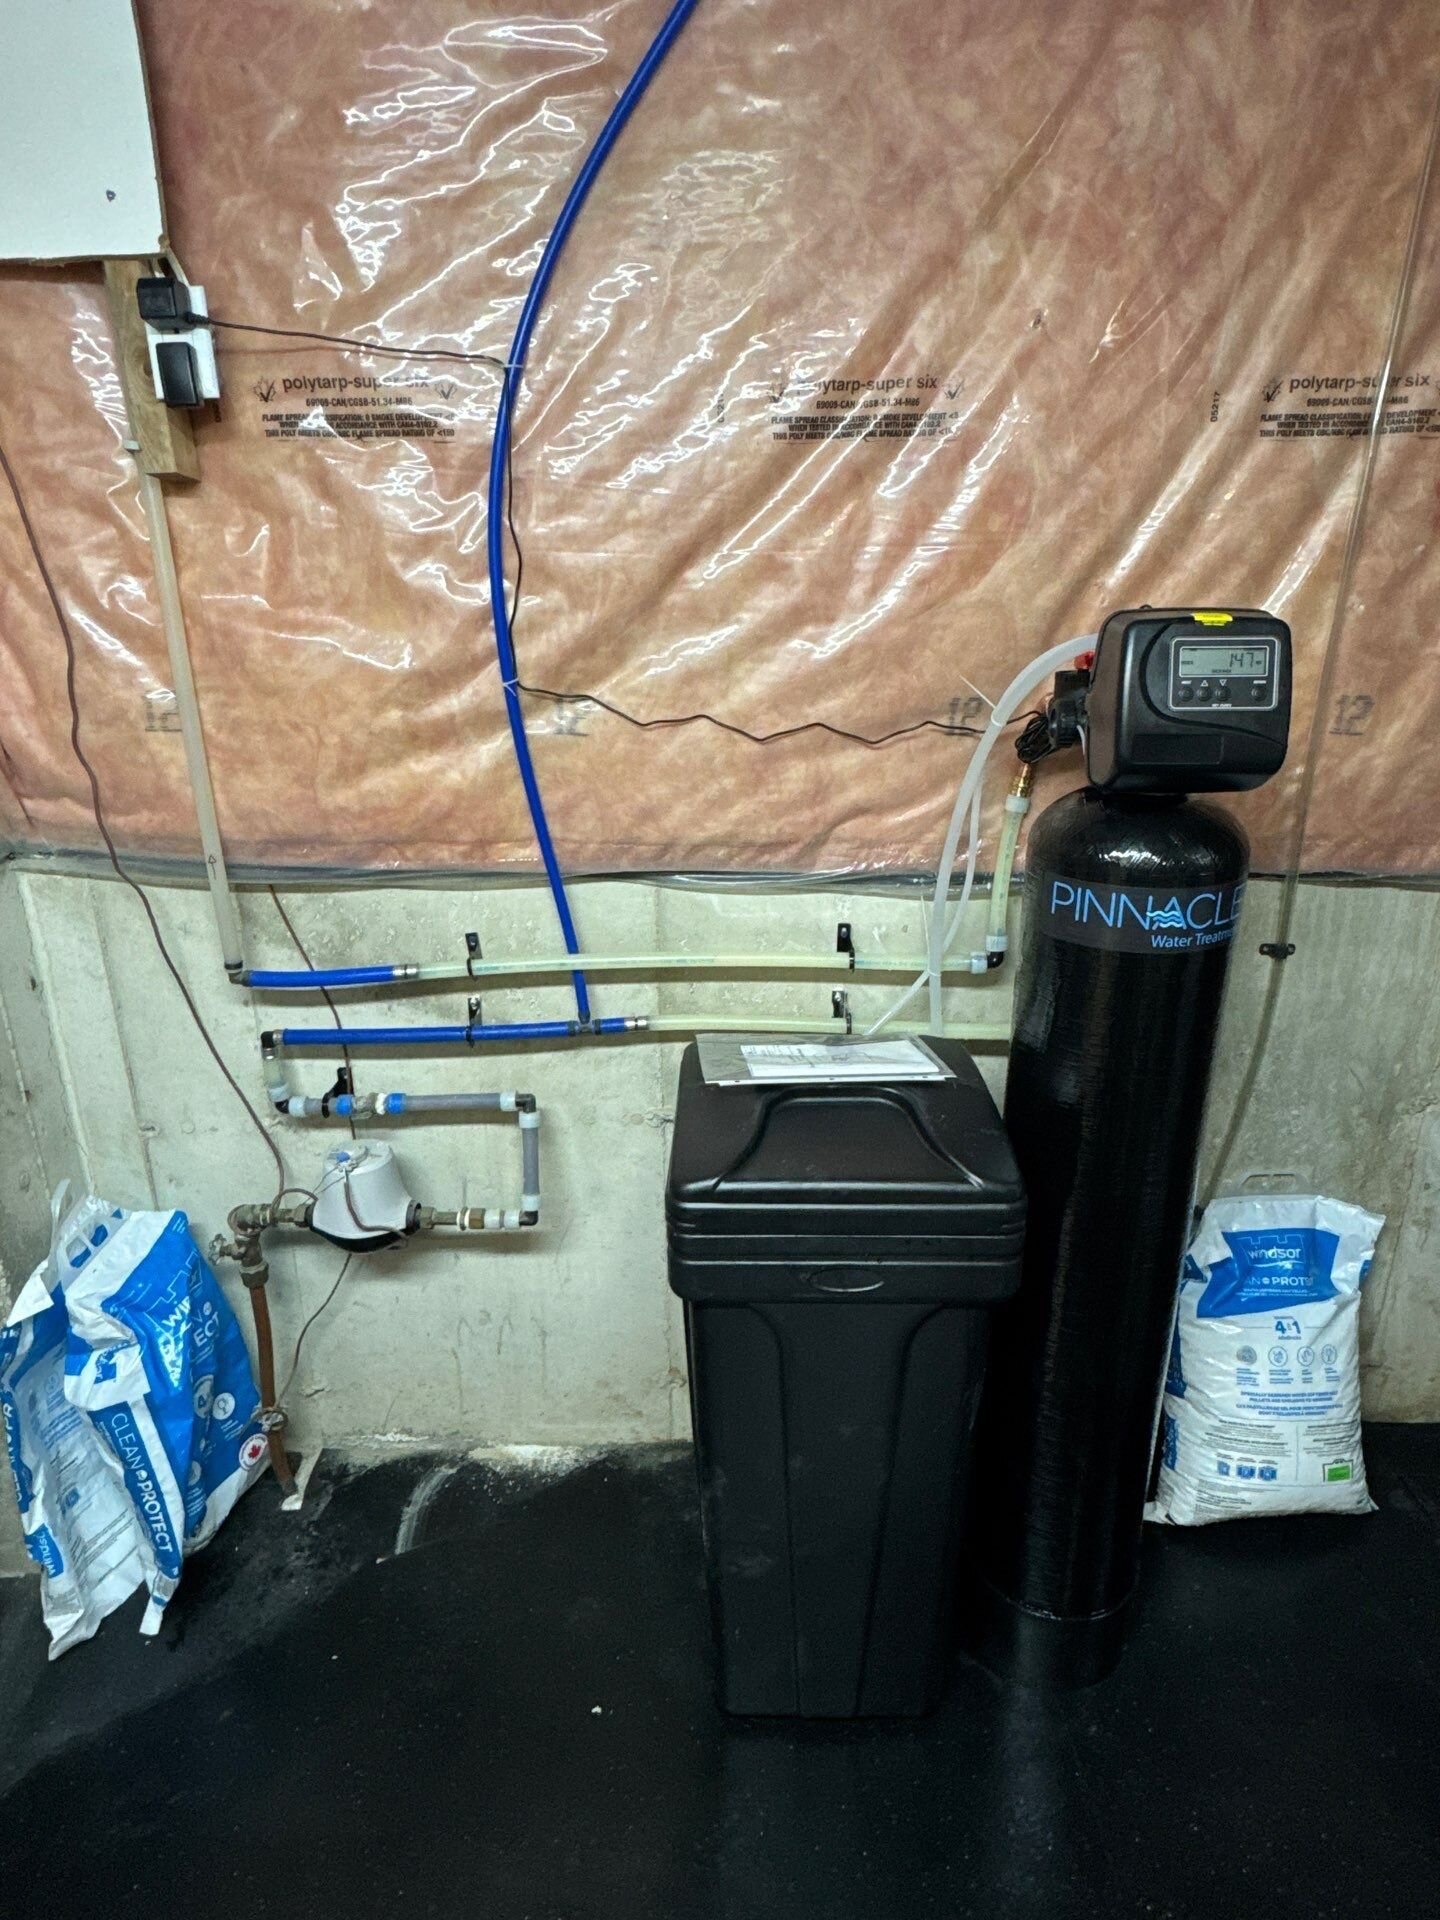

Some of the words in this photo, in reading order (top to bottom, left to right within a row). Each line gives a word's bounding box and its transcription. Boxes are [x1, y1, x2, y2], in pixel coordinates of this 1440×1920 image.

[916, 374, 938, 388] six
[1289, 376, 1401, 393] polytarp-suer
[1405, 373, 1430, 387] six
[816, 397, 920, 409] 69009-CANGSB-51.34-M86
[1209, 391, 1221, 423] 05217
[371, 413, 394, 421] SMOKE
[1051, 880, 1246, 931] PINNACLE
[1151, 934, 1193, 949] Water
[1248, 1246, 1302, 1260] windsor
[1275, 1320, 1287, 1335] 4
[1292, 1320, 1302, 1335] 1
[111, 1412, 145, 1470] CLEAN
[137, 1480, 173, 1554] PROTECT
